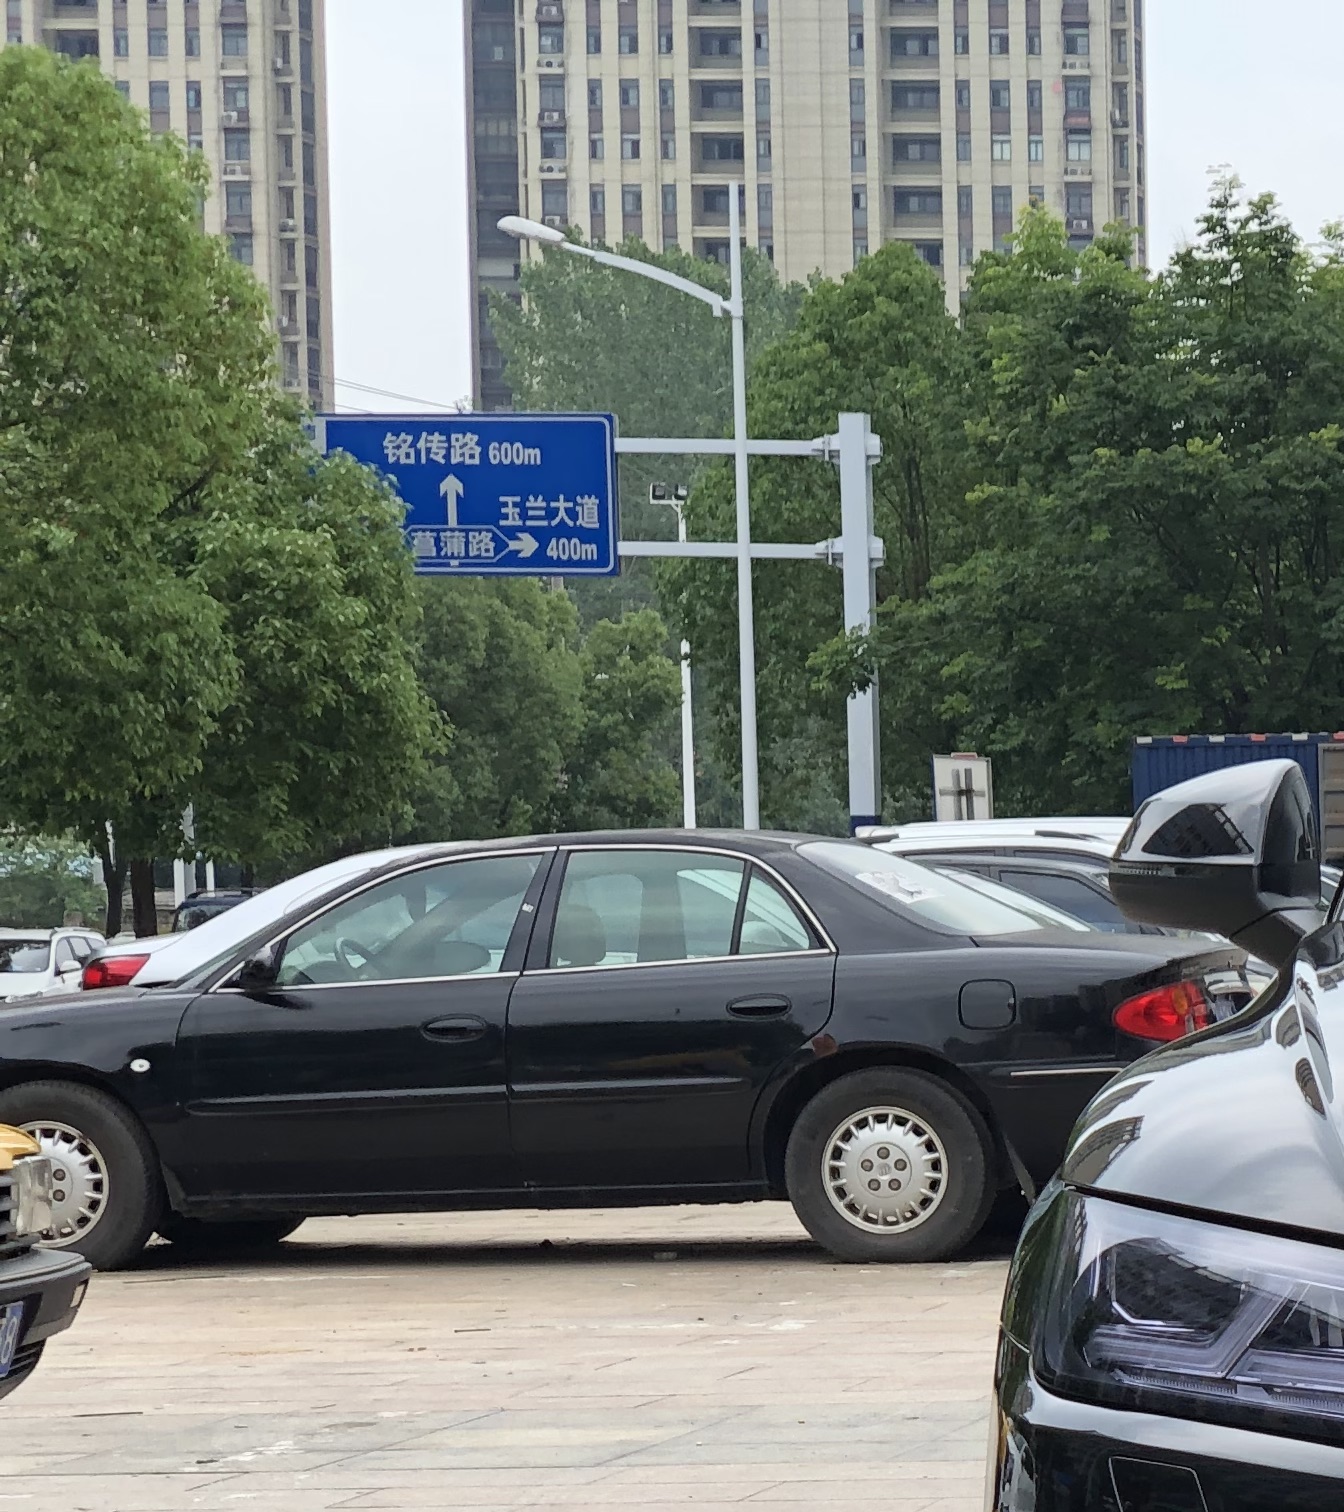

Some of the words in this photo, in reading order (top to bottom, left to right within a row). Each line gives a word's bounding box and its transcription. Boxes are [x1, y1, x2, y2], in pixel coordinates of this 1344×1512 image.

[382, 431, 482, 465] 铭传路
[488, 441, 542, 466] 600m
[498, 494, 600, 529] 玉兰大道
[546, 537, 598, 561] 400m
